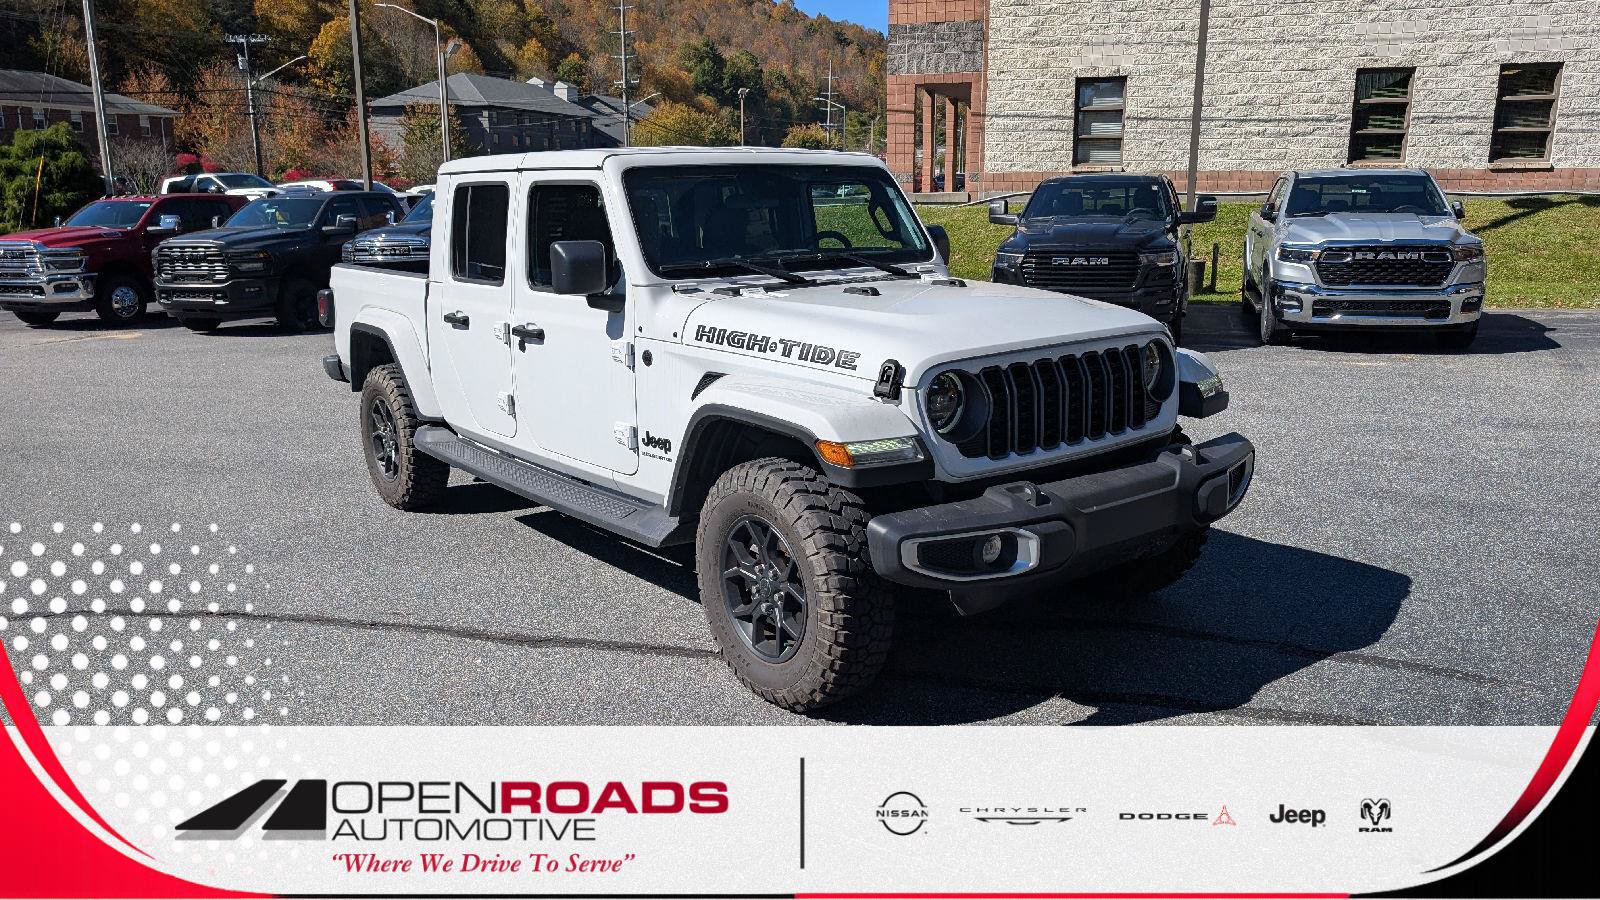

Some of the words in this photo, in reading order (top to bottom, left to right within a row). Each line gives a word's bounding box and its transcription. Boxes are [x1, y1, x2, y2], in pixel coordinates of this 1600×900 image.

[1353, 251, 1419, 260] RAM
[1051, 257, 1109, 265] RAM
[641, 430, 672, 455] Jeep
